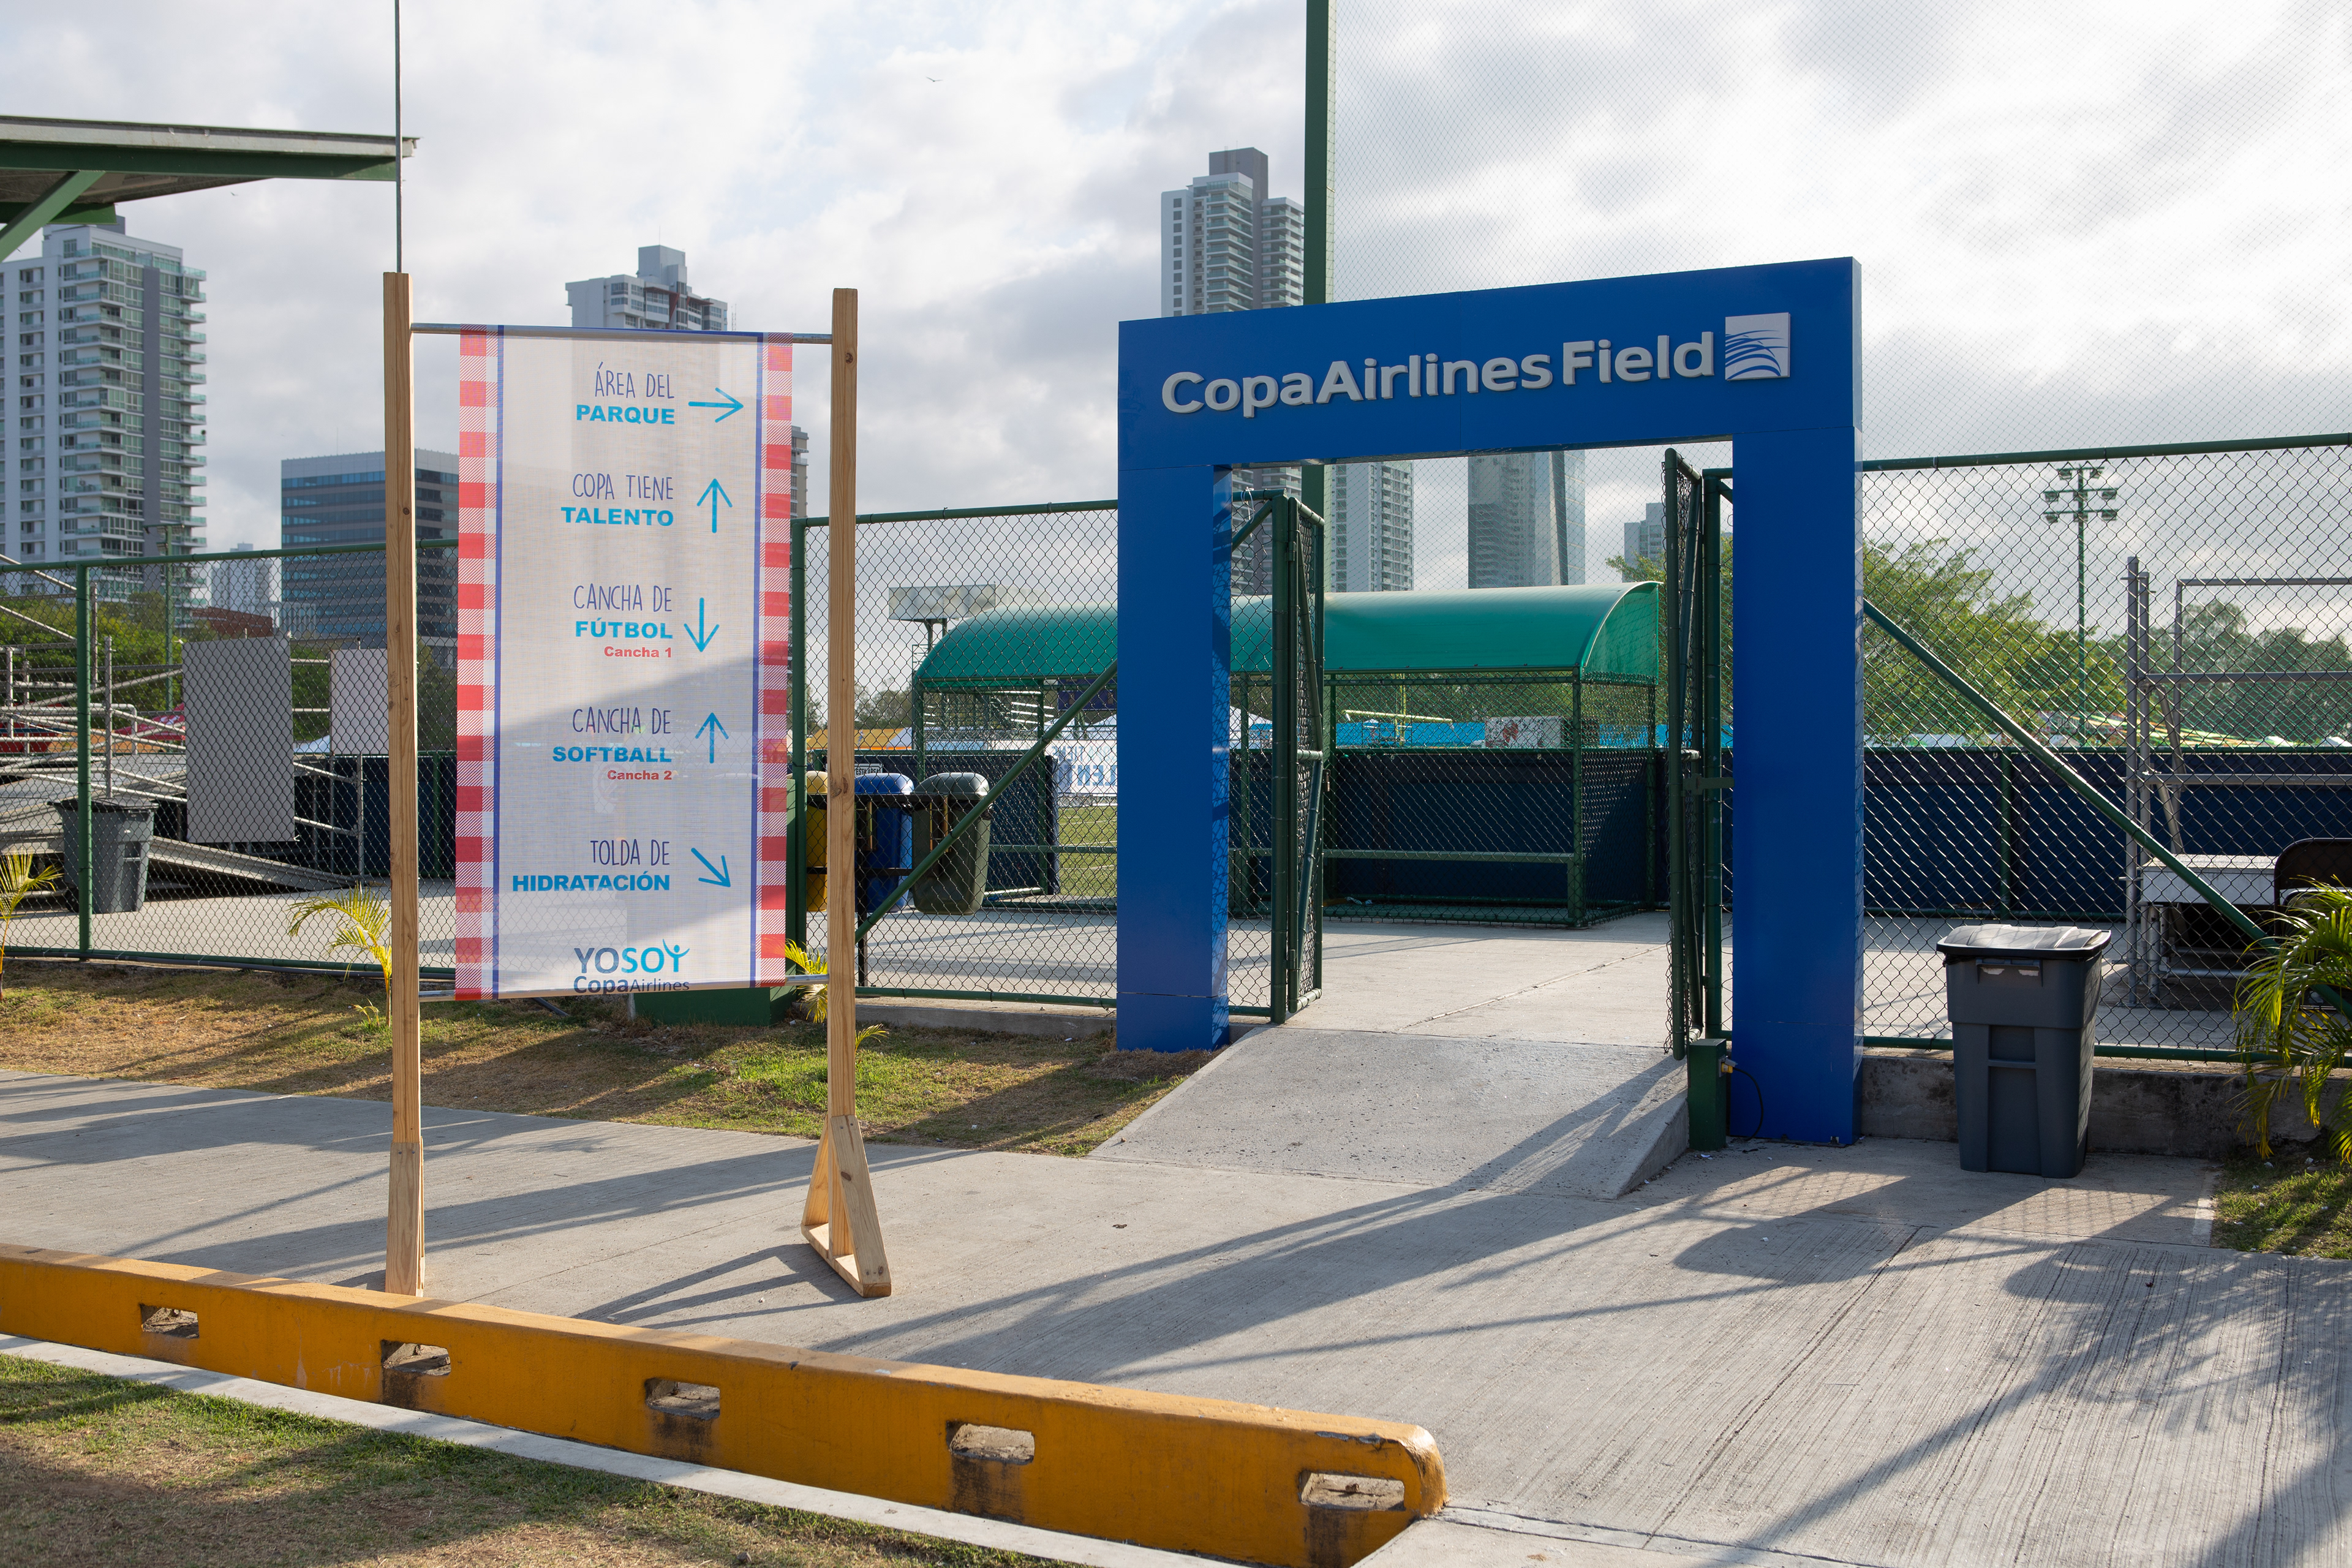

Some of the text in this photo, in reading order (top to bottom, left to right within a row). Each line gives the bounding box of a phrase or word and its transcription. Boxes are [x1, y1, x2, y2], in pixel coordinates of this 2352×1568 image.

[595, 361, 674, 399] ÁREA DEL
[1162, 331, 1714, 418] CopaAirlines Field
[576, 404, 675, 425] PARQUE
[572, 473, 674, 501] COPA TIENE
[560, 507, 674, 527] TALENTO
[573, 583, 673, 612] CANCHA DE
[575, 617, 673, 639] FÚTBOL
[604, 646, 672, 658] Cancha 1
[572, 706, 671, 734] CANCHA DE
[552, 746, 672, 763] SOFTBALL
[607, 770, 673, 780] Cancha 2
[590, 839, 670, 867] TOLDA DE
[512, 870, 670, 892] HIDRATACIÓN
[573, 976, 690, 995] CopaAirlines
